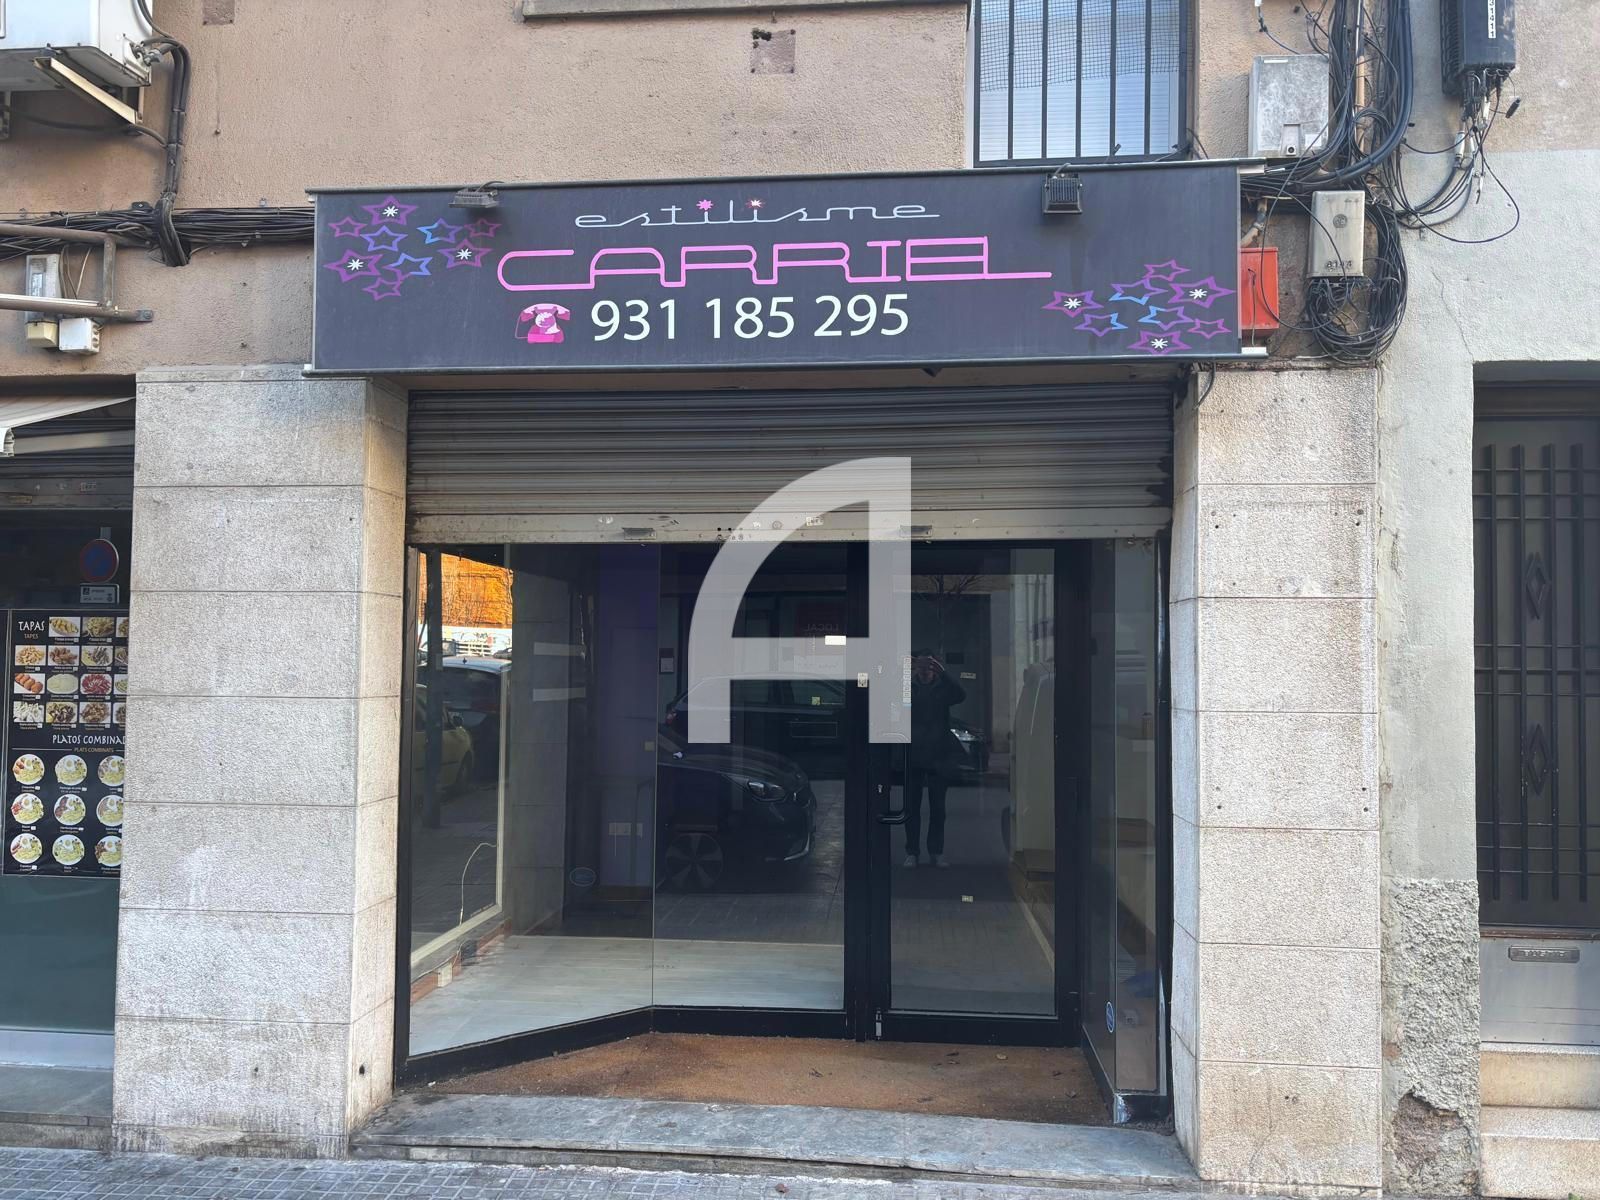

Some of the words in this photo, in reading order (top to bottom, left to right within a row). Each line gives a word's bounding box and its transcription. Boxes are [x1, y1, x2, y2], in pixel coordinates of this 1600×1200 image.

[575, 199, 940, 227] estilisme
[497, 236, 1052, 291] CARRIEL
[591, 299, 676, 341] 931
[705, 296, 795, 339] 185
[813, 293, 909, 337] 295
[18, 620, 45, 631] TAPAS
[52, 734, 81, 744] PLATOS
